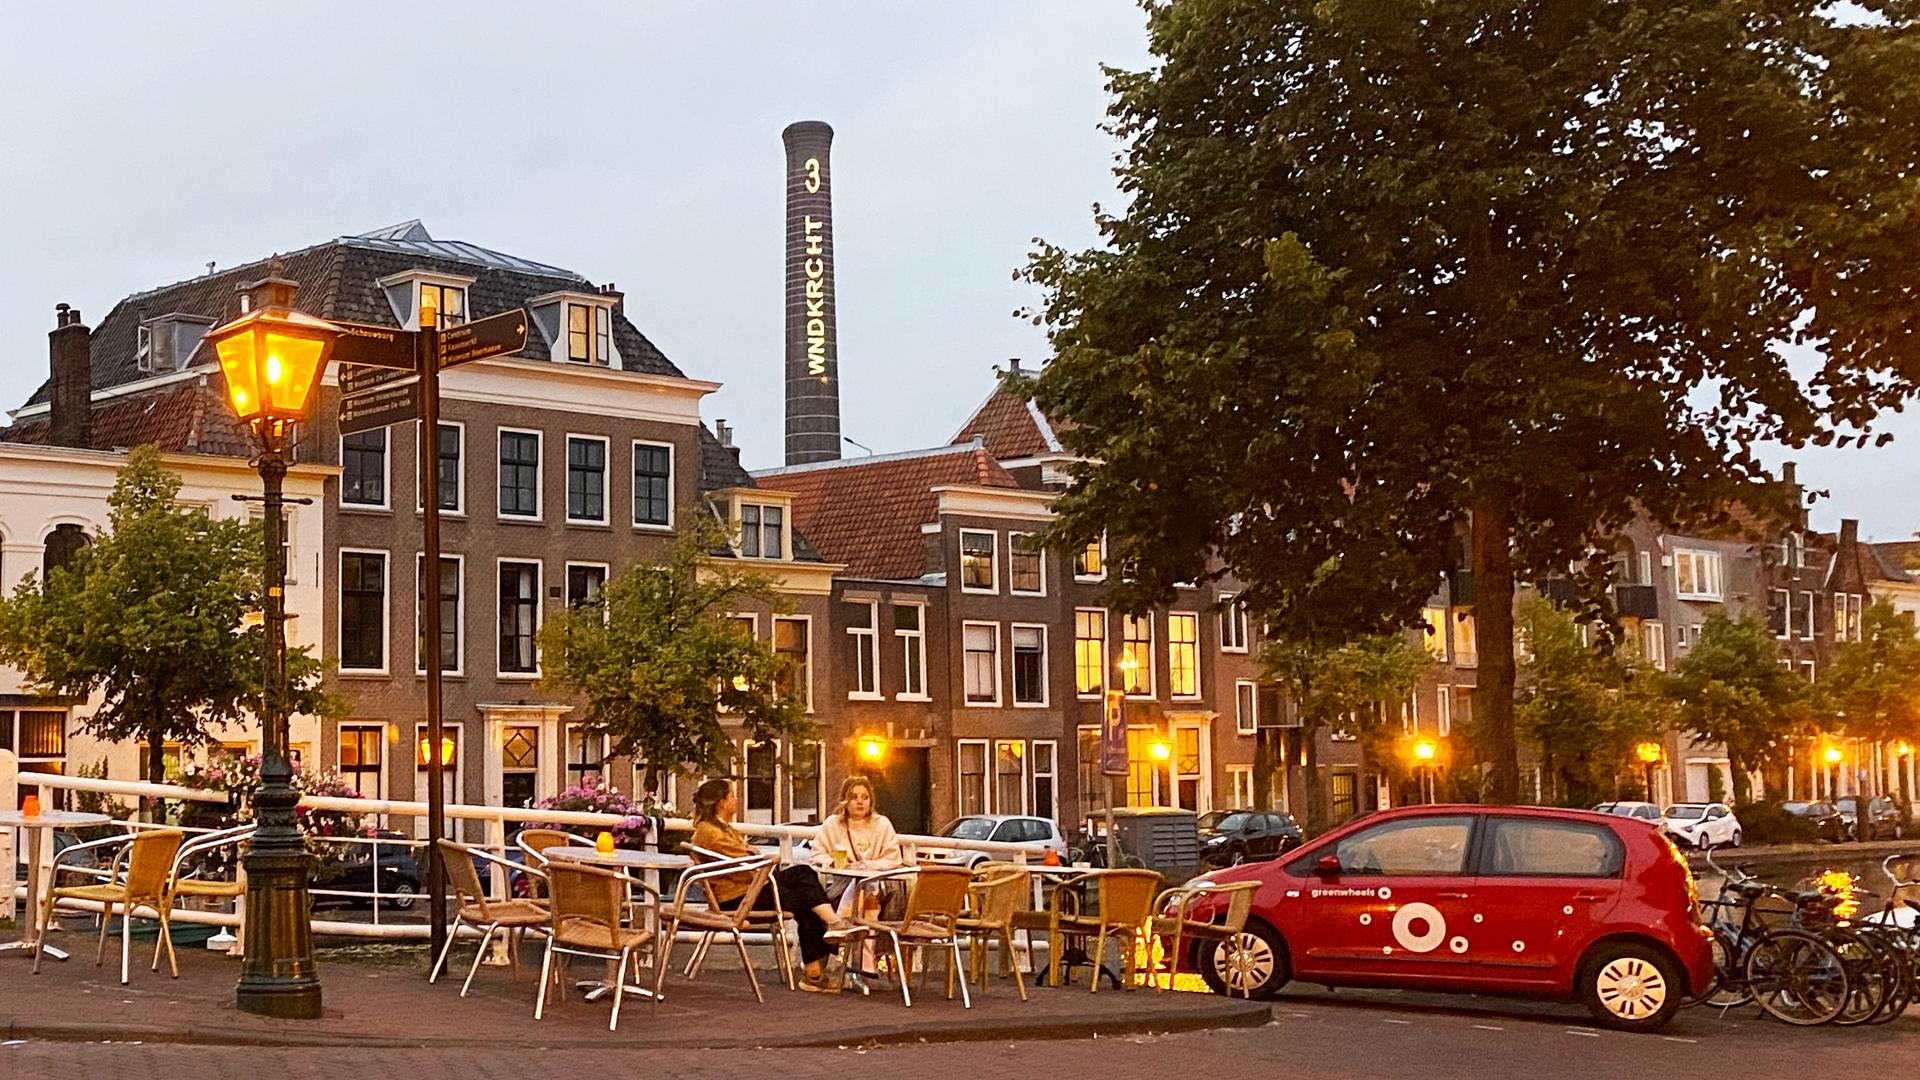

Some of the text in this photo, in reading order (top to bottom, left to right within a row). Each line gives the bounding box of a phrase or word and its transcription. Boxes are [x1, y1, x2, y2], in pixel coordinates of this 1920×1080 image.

[805, 158, 820, 193] 3
[804, 215, 826, 375] WNDKRCHT
[1109, 701, 1121, 741] P
[1311, 888, 1375, 898] greenwheels
